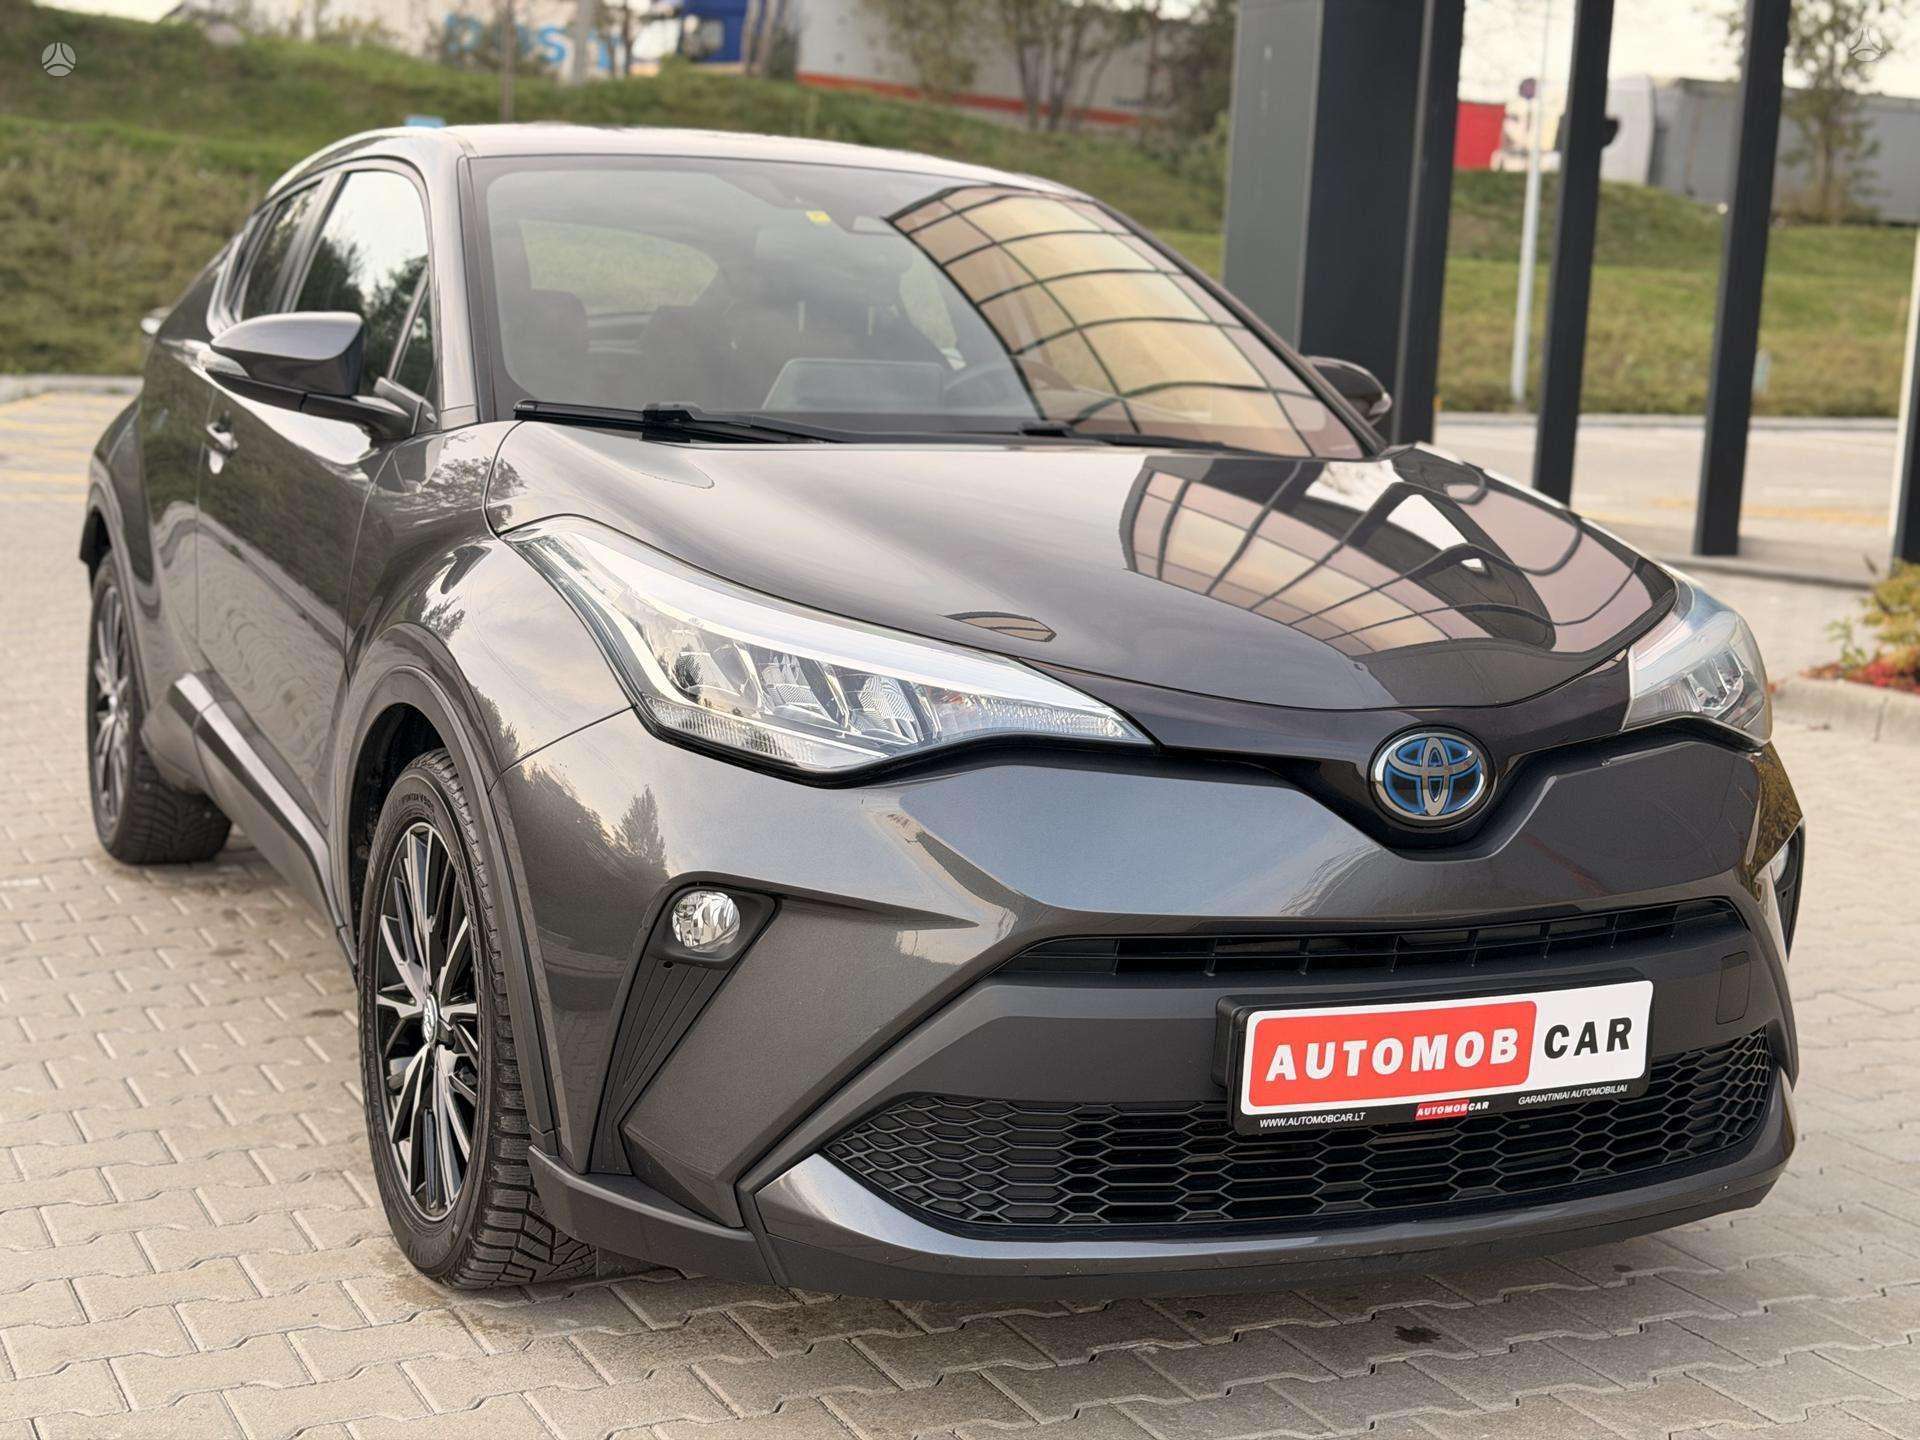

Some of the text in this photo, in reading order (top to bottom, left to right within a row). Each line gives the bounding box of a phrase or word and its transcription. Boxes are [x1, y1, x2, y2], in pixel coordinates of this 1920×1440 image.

[1518, 1085, 1628, 1105] GARANTINIAI AUTOMOBILIAI
[1259, 1112, 1366, 1128] WWW.AUTOMOBCAR.LT
